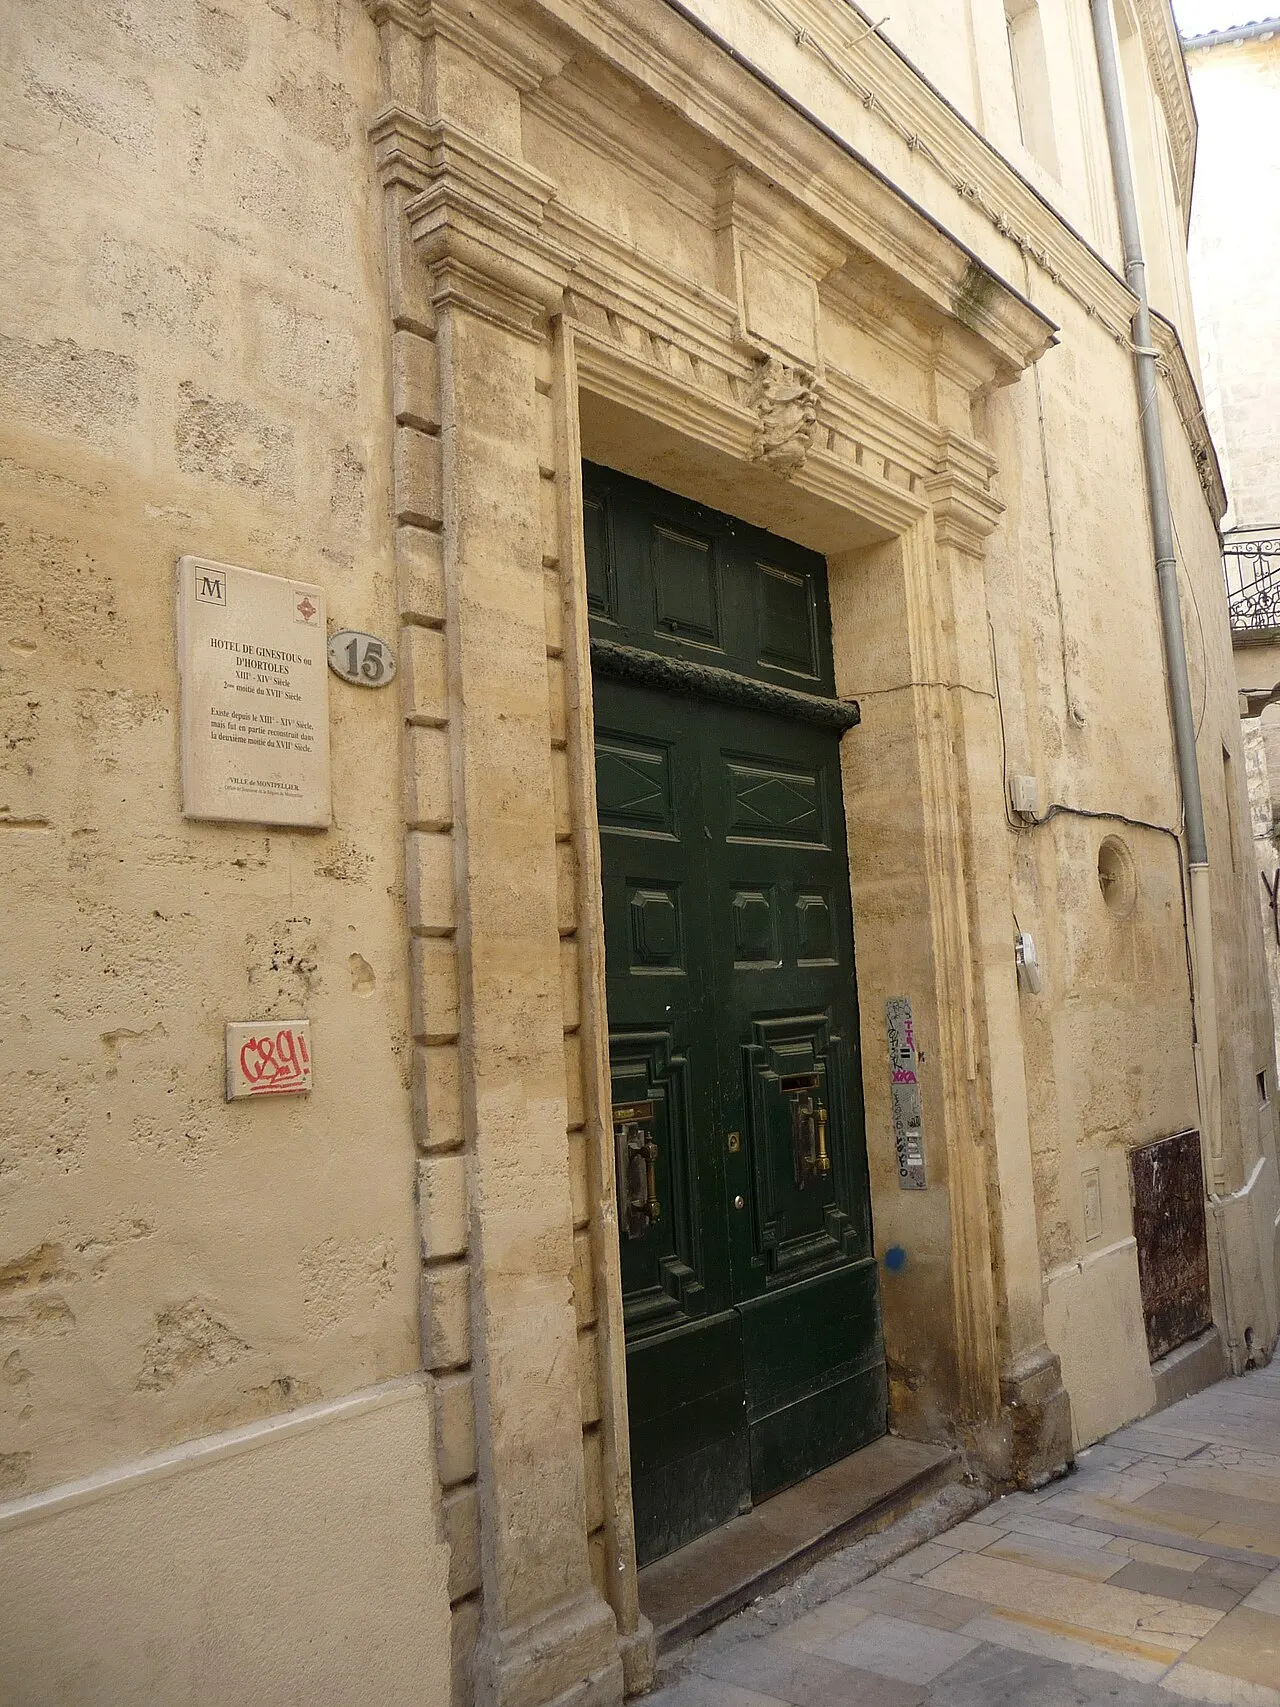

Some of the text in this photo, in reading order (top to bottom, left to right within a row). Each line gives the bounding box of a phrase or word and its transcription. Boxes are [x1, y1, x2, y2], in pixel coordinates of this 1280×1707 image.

[200, 576, 222, 598] M
[210, 637, 312, 666] HOTEL DE GINESTOUS ou
[344, 637, 384, 680] 15
[236, 656, 289, 674] D'HORTOLES
[256, 687, 265, 696] du
[210, 707, 230, 718] Existe
[231, 710, 251, 721] depuis
[210, 720, 226, 729] mais
[227, 721, 237, 731] fut
[248, 726, 266, 735] partie
[267, 728, 299, 740] reconstruit
[300, 732, 314, 741] dans
[210, 731, 217, 740] la
[266, 739, 275, 748] du
[229, 776, 248, 785] VILLE
